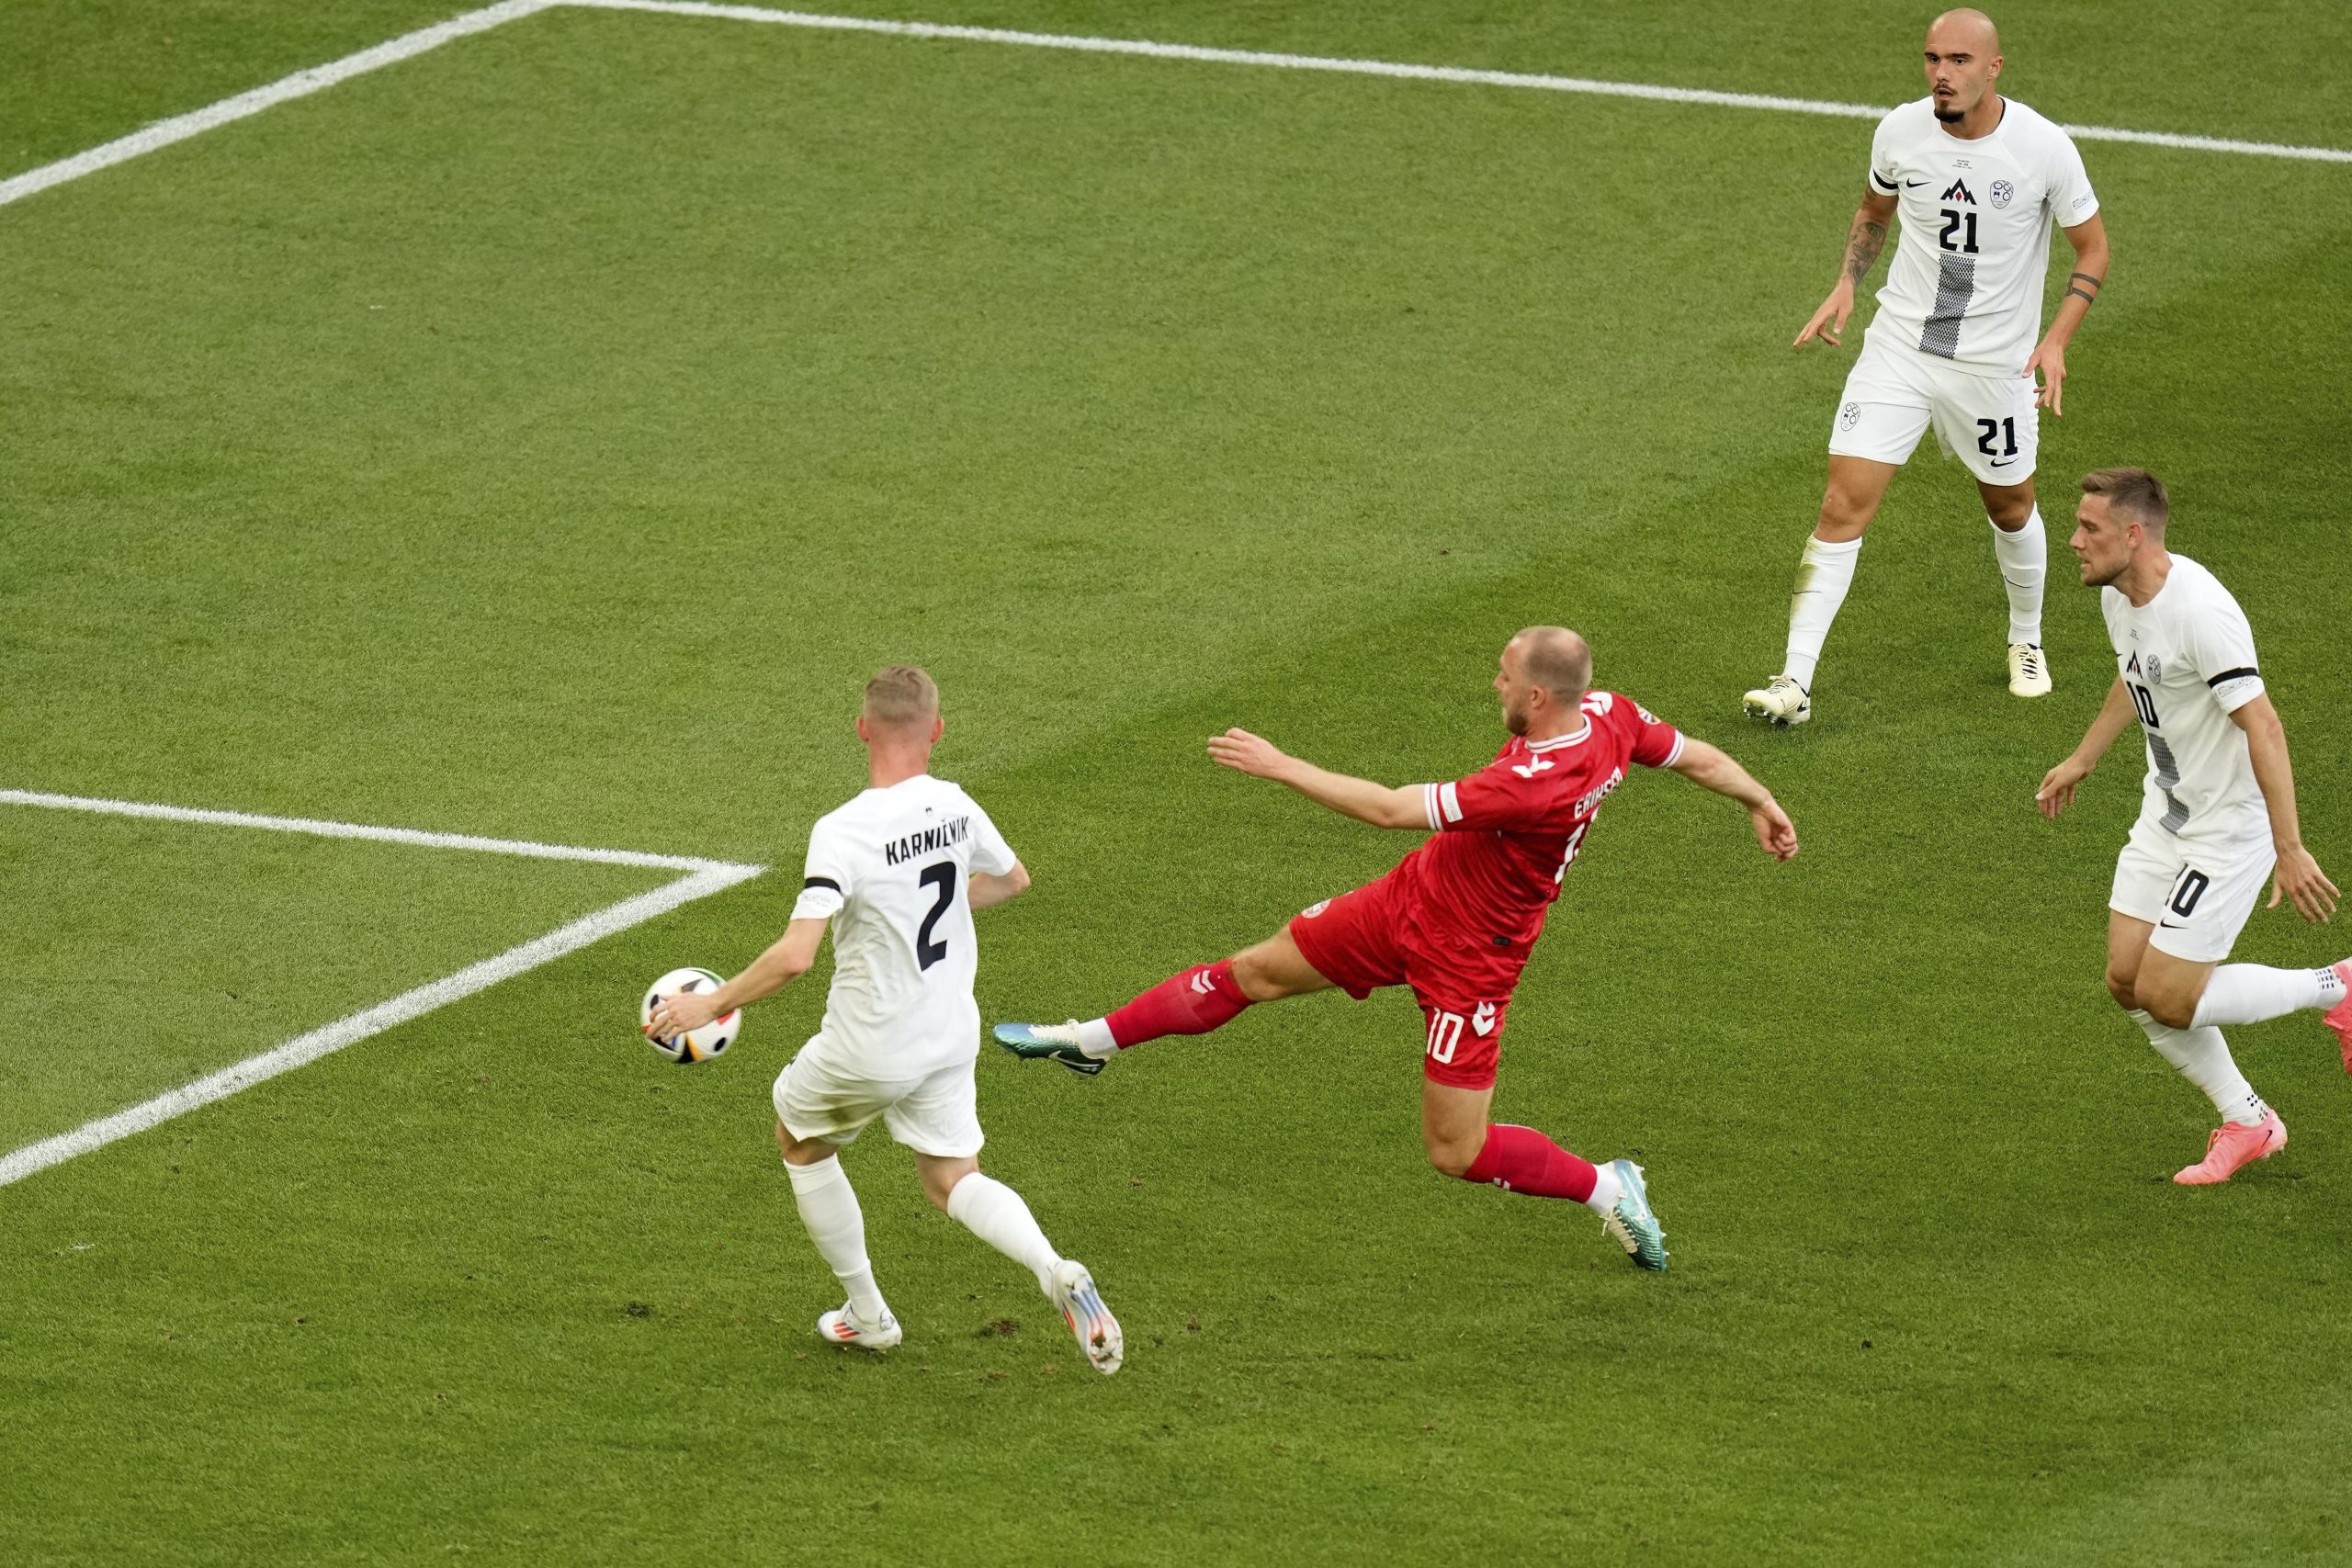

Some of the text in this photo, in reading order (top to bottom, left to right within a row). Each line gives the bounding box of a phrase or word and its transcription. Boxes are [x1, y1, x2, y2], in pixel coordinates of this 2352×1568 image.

[1939, 209, 1978, 254] 21
[1977, 416, 2018, 457] 21
[2126, 681, 2160, 728] 10
[917, 862, 956, 972] 2
[1426, 1006, 1464, 1064] 10
